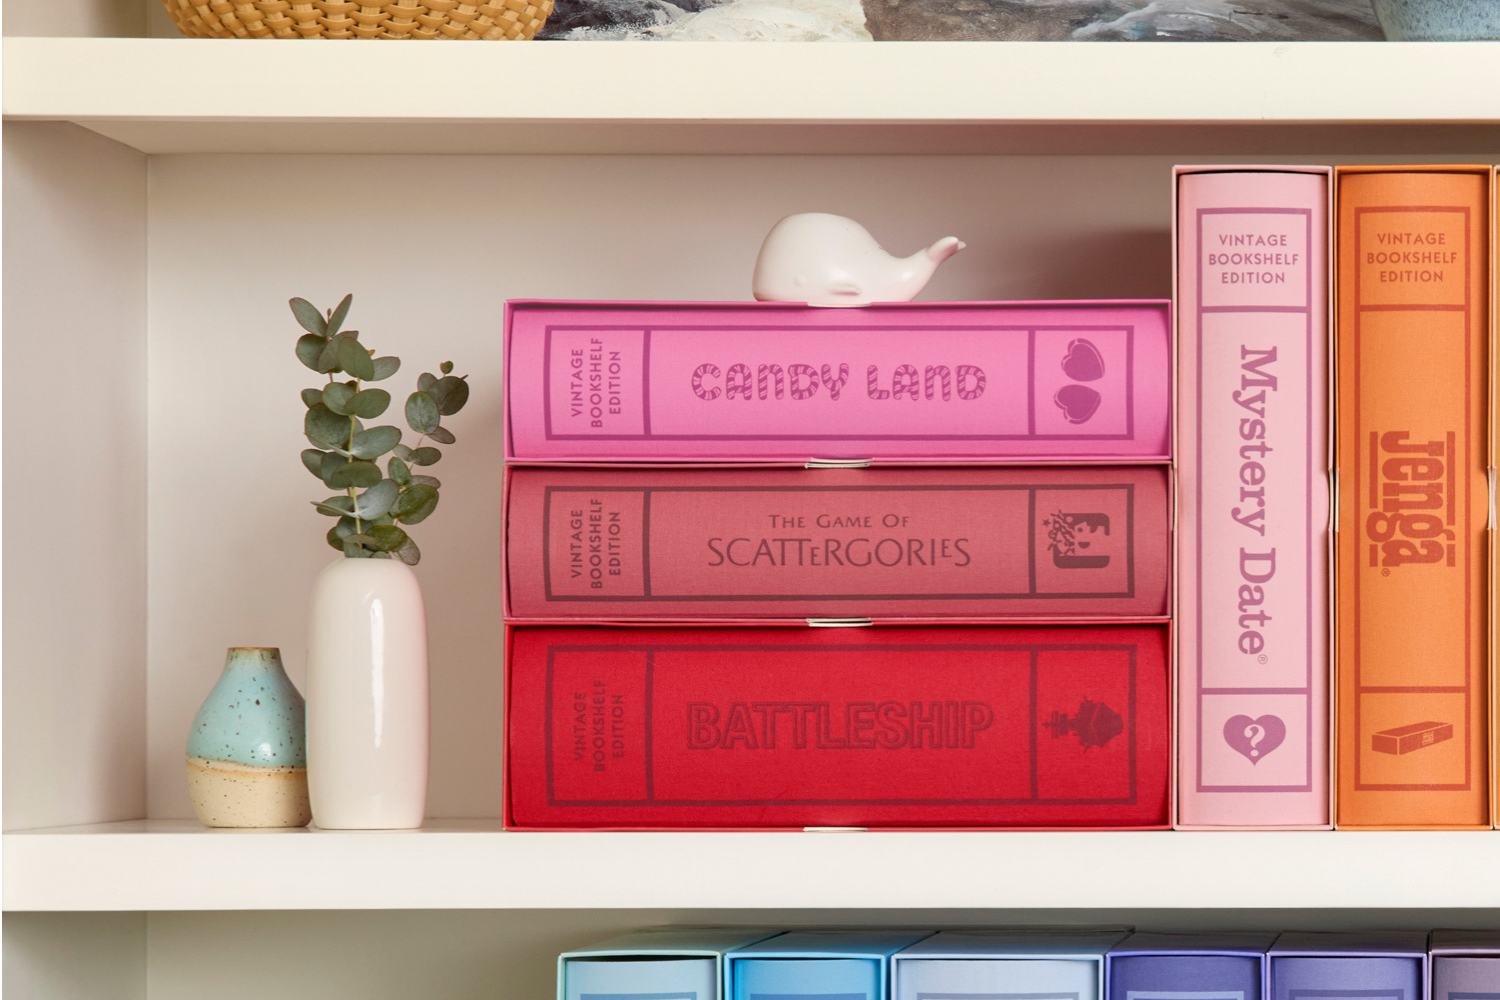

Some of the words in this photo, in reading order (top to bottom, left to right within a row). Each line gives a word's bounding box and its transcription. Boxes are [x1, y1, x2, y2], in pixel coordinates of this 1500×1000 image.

[1208, 252, 1299, 266] BOOKSHELF
[1219, 234, 1288, 247] VINTAGE
[1366, 251, 1458, 265] BOOKSHELF
[1376, 232, 1446, 245] VINTAGE
[1221, 272, 1285, 284] EDITION
[1380, 270, 1444, 282] EDITION
[570, 348, 584, 418] VINTAGE
[590, 337, 603, 428] BOOKSHELF
[609, 350, 622, 415] EDITION
[691, 362, 850, 401] CANDY
[866, 364, 987, 402] LAND
[1231, 344, 1278, 536] Mystery
[1366, 431, 1456, 567] Jenga
[570, 508, 584, 579] VINTAGE
[590, 498, 603, 590] BOOKSHELF
[609, 511, 622, 577] EDITION
[708, 537, 971, 568] SCATTERGORIES
[1238, 547, 1276, 655] Date
[573, 691, 586, 761] VINTAGE
[594, 680, 606, 772] BOOKSHELF
[612, 692, 624, 759] EDITION
[687, 700, 994, 750] BATTLESHIP
